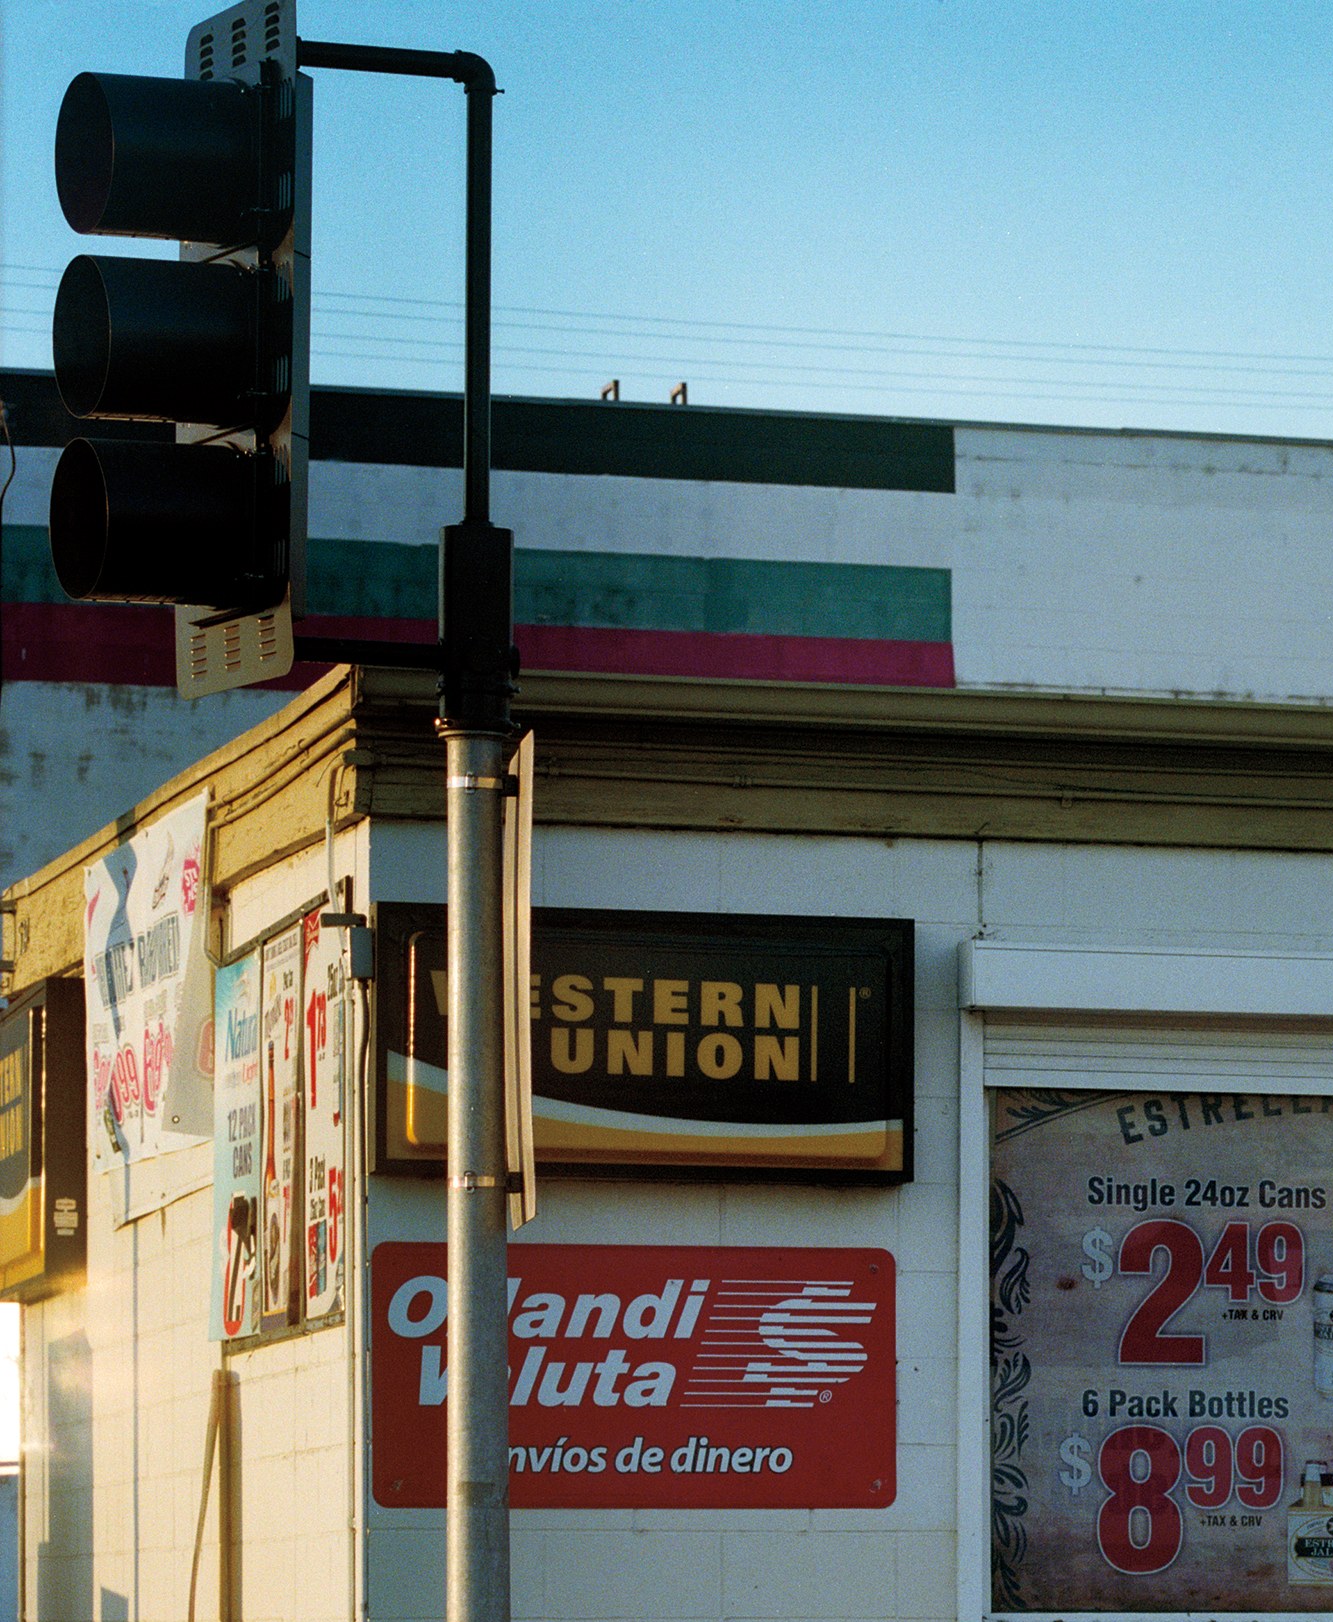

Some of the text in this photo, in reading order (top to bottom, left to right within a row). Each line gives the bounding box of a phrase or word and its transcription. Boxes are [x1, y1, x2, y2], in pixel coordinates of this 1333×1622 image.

[430, 970, 800, 1029] STERN
[551, 1027, 799, 1081] UNION
[1088, 1176, 1326, 1212] Single 24oz Cans
[388, 1275, 711, 1338] Oandi
[1262, 1308, 1285, 1321] CRV
[419, 1345, 676, 1407] Vluta
[1082, 1389, 1289, 1419] 6 Pack Bottles
[508, 1436, 794, 1474] nvíos de dinero
